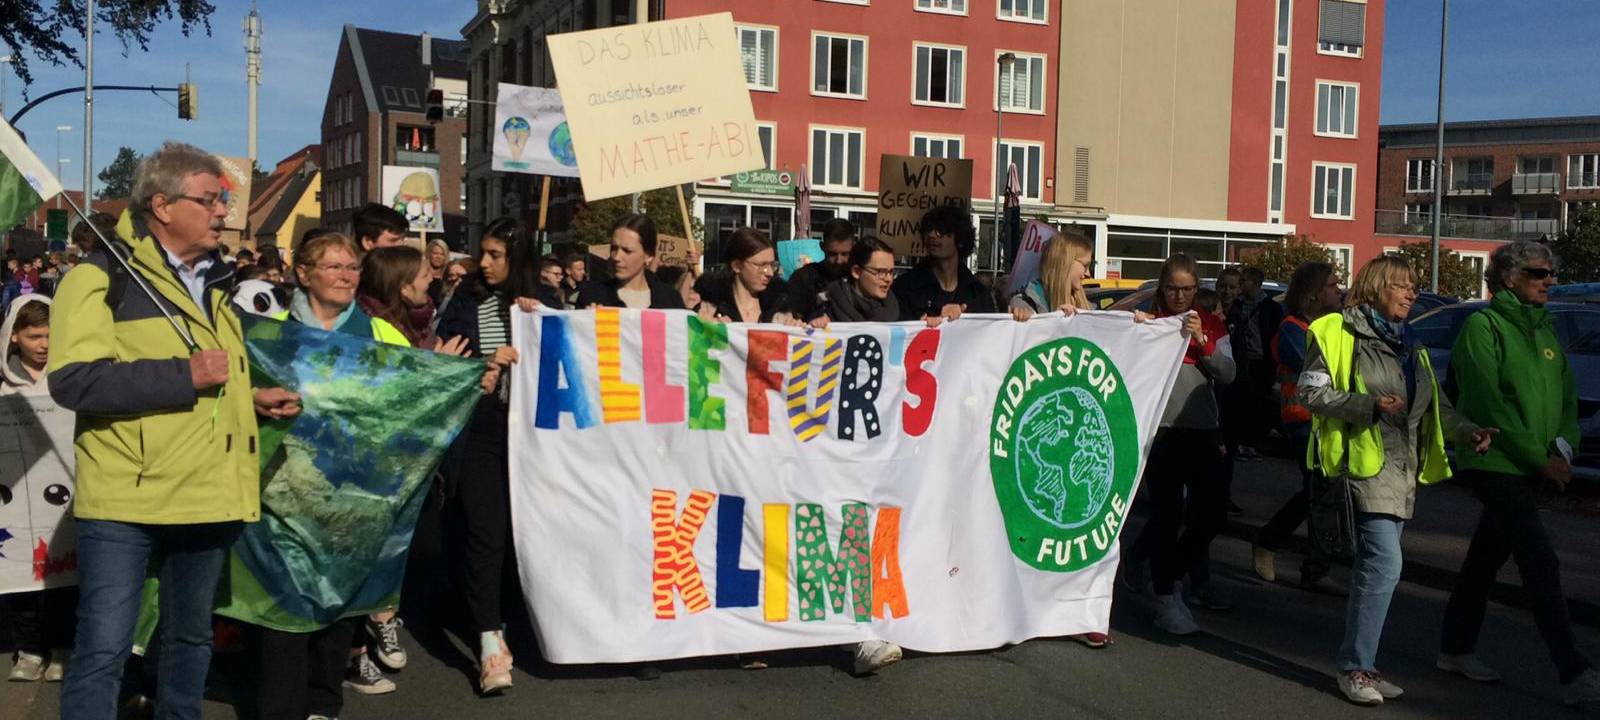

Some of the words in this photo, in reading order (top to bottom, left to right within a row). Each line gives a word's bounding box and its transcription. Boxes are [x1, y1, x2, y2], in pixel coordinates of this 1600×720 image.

[577, 32, 631, 65] DAS
[642, 23, 713, 57] KLIMA
[588, 82, 686, 107] aussichtsloser
[667, 106, 703, 121] unser
[600, 122, 753, 183] MATHE-ABI
[903, 161, 946, 189] WIR
[880, 190, 938, 210] GEGEN
[534, 308, 729, 431] ALLE
[993, 344, 1073, 459] FRIDAYS
[1076, 346, 1118, 402] FOR
[1036, 492, 1127, 566] FUTURE
[652, 488, 910, 623] KLIMA
